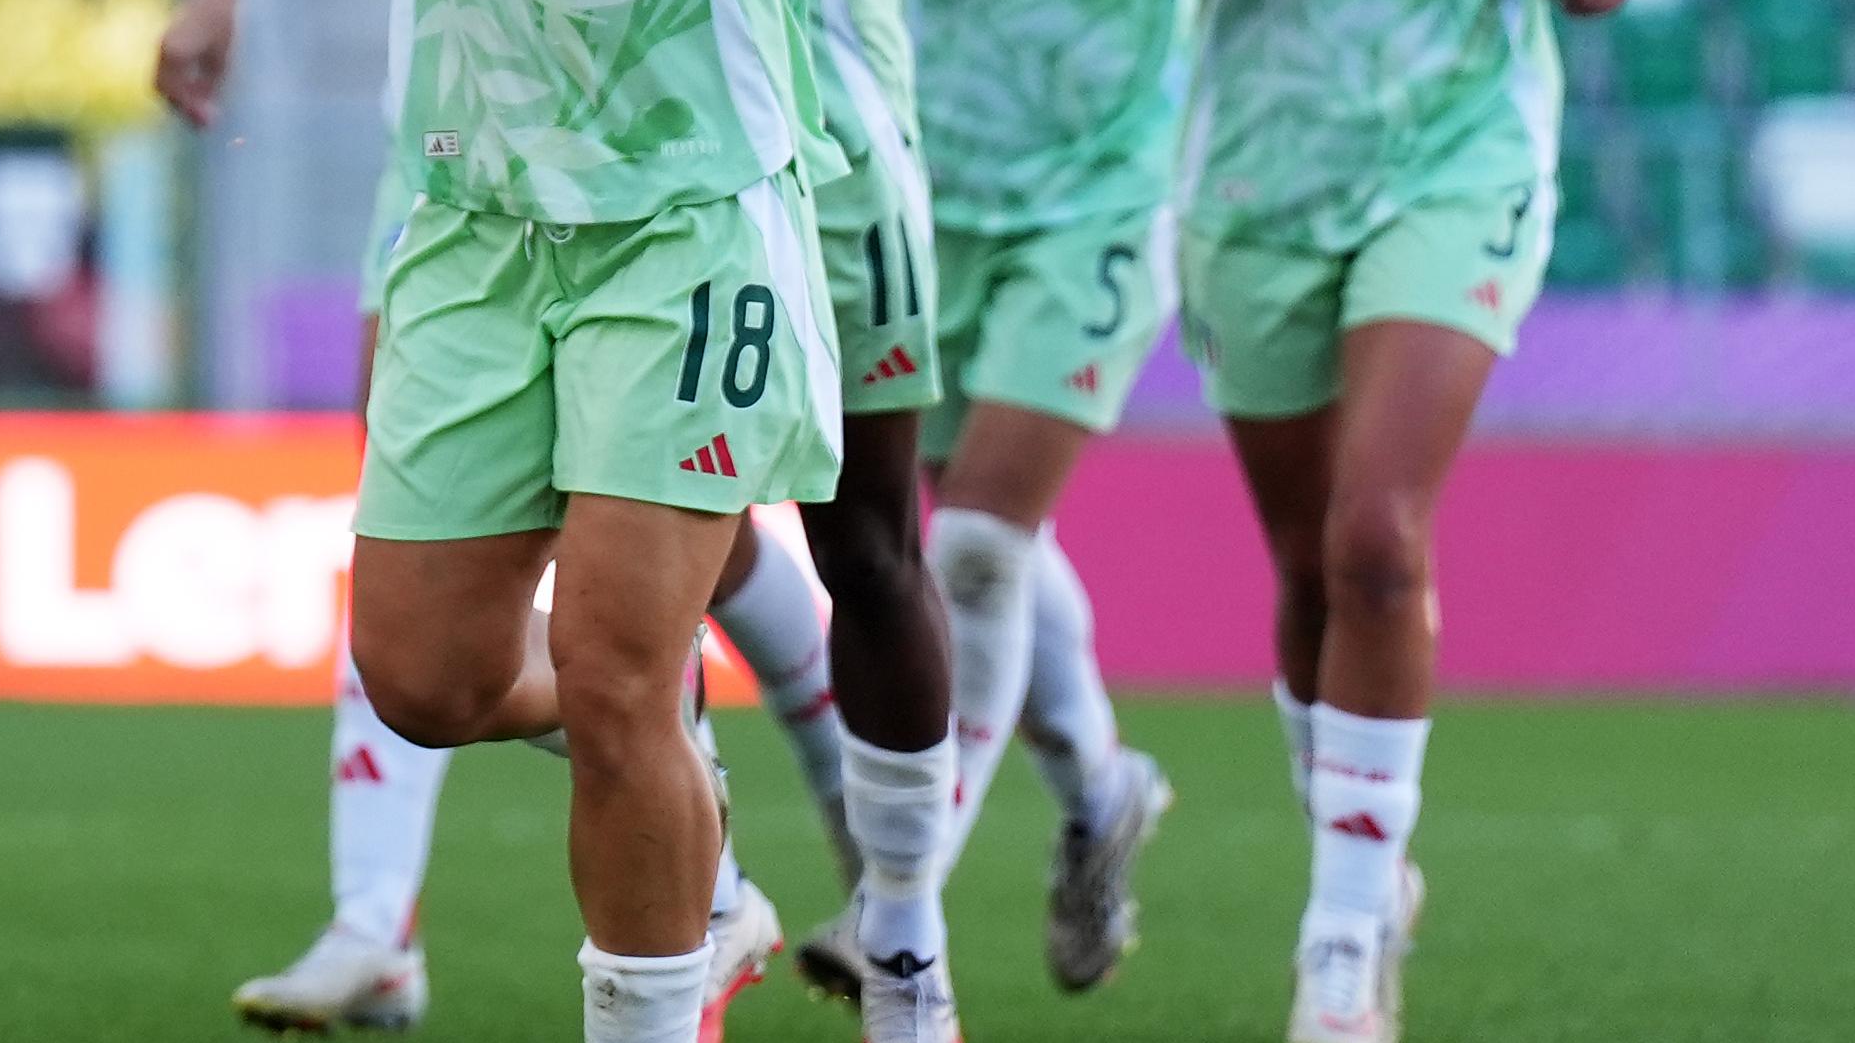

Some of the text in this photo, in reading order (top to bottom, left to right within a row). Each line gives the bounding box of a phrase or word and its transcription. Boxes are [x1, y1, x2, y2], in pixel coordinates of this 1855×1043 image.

[863, 219, 920, 328] 11
[1082, 243, 1136, 339] 5
[674, 280, 779, 410] 18
